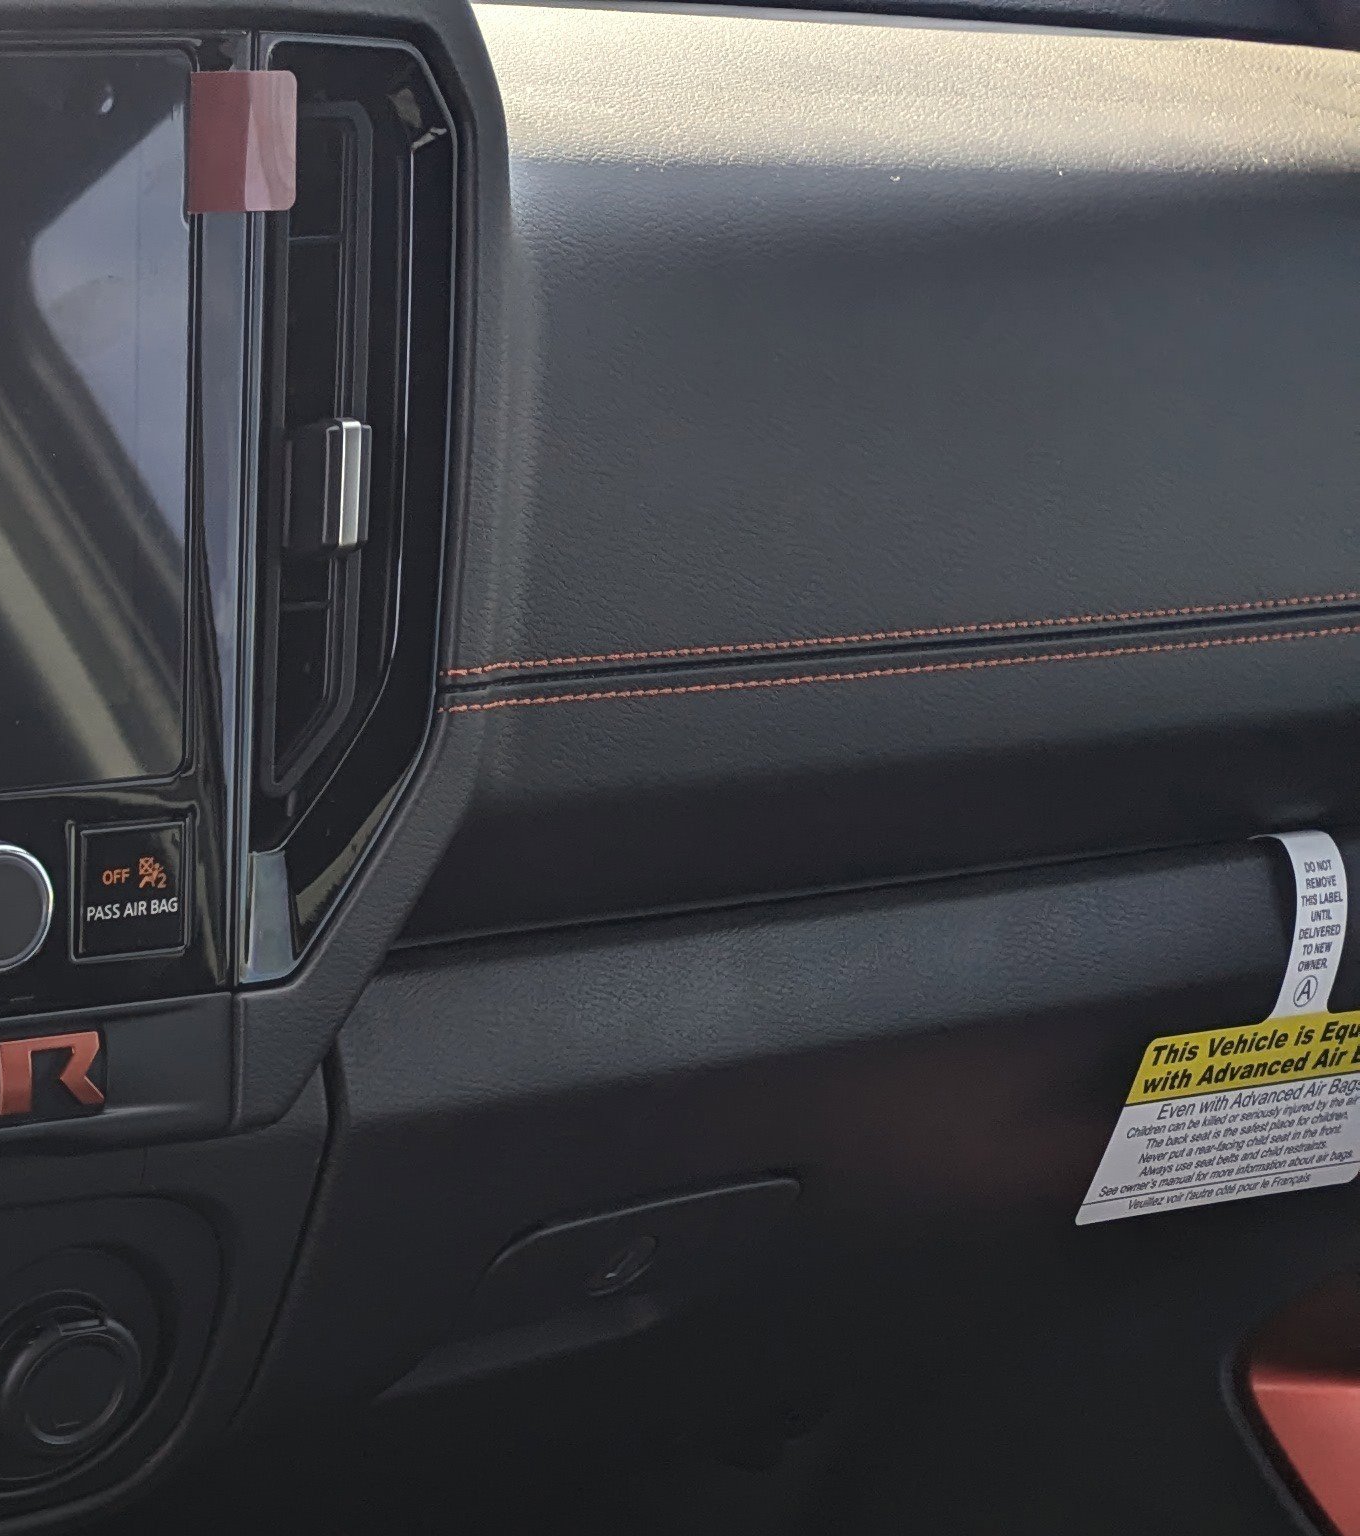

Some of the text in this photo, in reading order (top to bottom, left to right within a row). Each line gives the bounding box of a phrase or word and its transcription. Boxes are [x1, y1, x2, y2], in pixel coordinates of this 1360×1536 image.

[102, 867, 130, 886] OFF
[1304, 859, 1332, 873] DO NOT
[1306, 875, 1337, 889] REMOVE
[86, 896, 179, 922] PASS AIR BAG
[1301, 891, 1343, 907] THIS LABEL
[1311, 909, 1332, 923] UNTIL
[1298, 924, 1341, 940] DELIVERED
[1302, 941, 1333, 956] TO NEW
[1296, 979, 1312, 1002] A
[1152, 1041, 1200, 1067] This
[1208, 1029, 1289, 1058] Vehicle
[1293, 1025, 1315, 1046] is
[1143, 1068, 1192, 1094] with
[1196, 1051, 1311, 1086] Advanced
[1311, 1047, 1348, 1070] Air
[1156, 1102, 1196, 1120] Even
[1199, 1095, 1229, 1114] with
[1230, 1083, 1305, 1109] Advanced
[1303, 1080, 1327, 1099] Air
[1126, 1125, 1166, 1139] Children
[1168, 1121, 1186, 1132] can
[1187, 1119, 1201, 1130] be
[1201, 1114, 1228, 1127] killed
[1228, 1114, 1239, 1123] or
[1240, 1105, 1282, 1121] seriously
[1282, 1101, 1315, 1117] injured
[1316, 1100, 1327, 1112] by
[1329, 1097, 1344, 1108] the
[1146, 1138, 1164, 1149] The
[1166, 1133, 1189, 1146] back
[1190, 1130, 1212, 1143] seat
[1212, 1129, 1221, 1139] is
[1223, 1127, 1238, 1137] the
[1240, 1121, 1269, 1135] safest
[1269, 1119, 1295, 1132] place
[1296, 1116, 1310, 1126] for
[1138, 1151, 1169, 1164] Never
[1169, 1148, 1186, 1162] put
[1246, 1134, 1270, 1147] child
[1270, 1131, 1291, 1143] seat
[1292, 1131, 1301, 1140] in
[1302, 1128, 1317, 1139] the
[1099, 1186, 1119, 1197] See
[1158, 1173, 1195, 1188] manual
[1195, 1171, 1209, 1181] for
[1210, 1168, 1234, 1179] more
[1235, 1159, 1287, 1175] information
[1288, 1155, 1315, 1167] about
[1316, 1153, 1329, 1162] air
[1139, 1164, 1174, 1177] Always
[1175, 1161, 1193, 1172] use
[1194, 1156, 1216, 1169] seat
[1241, 1149, 1260, 1161] and
[1261, 1145, 1284, 1158] child
[1129, 1196, 1165, 1210] Veuillez
[1166, 1192, 1184, 1203] voir
[1236, 1182, 1260, 1194] pour
[1260, 1178, 1269, 1188] le
